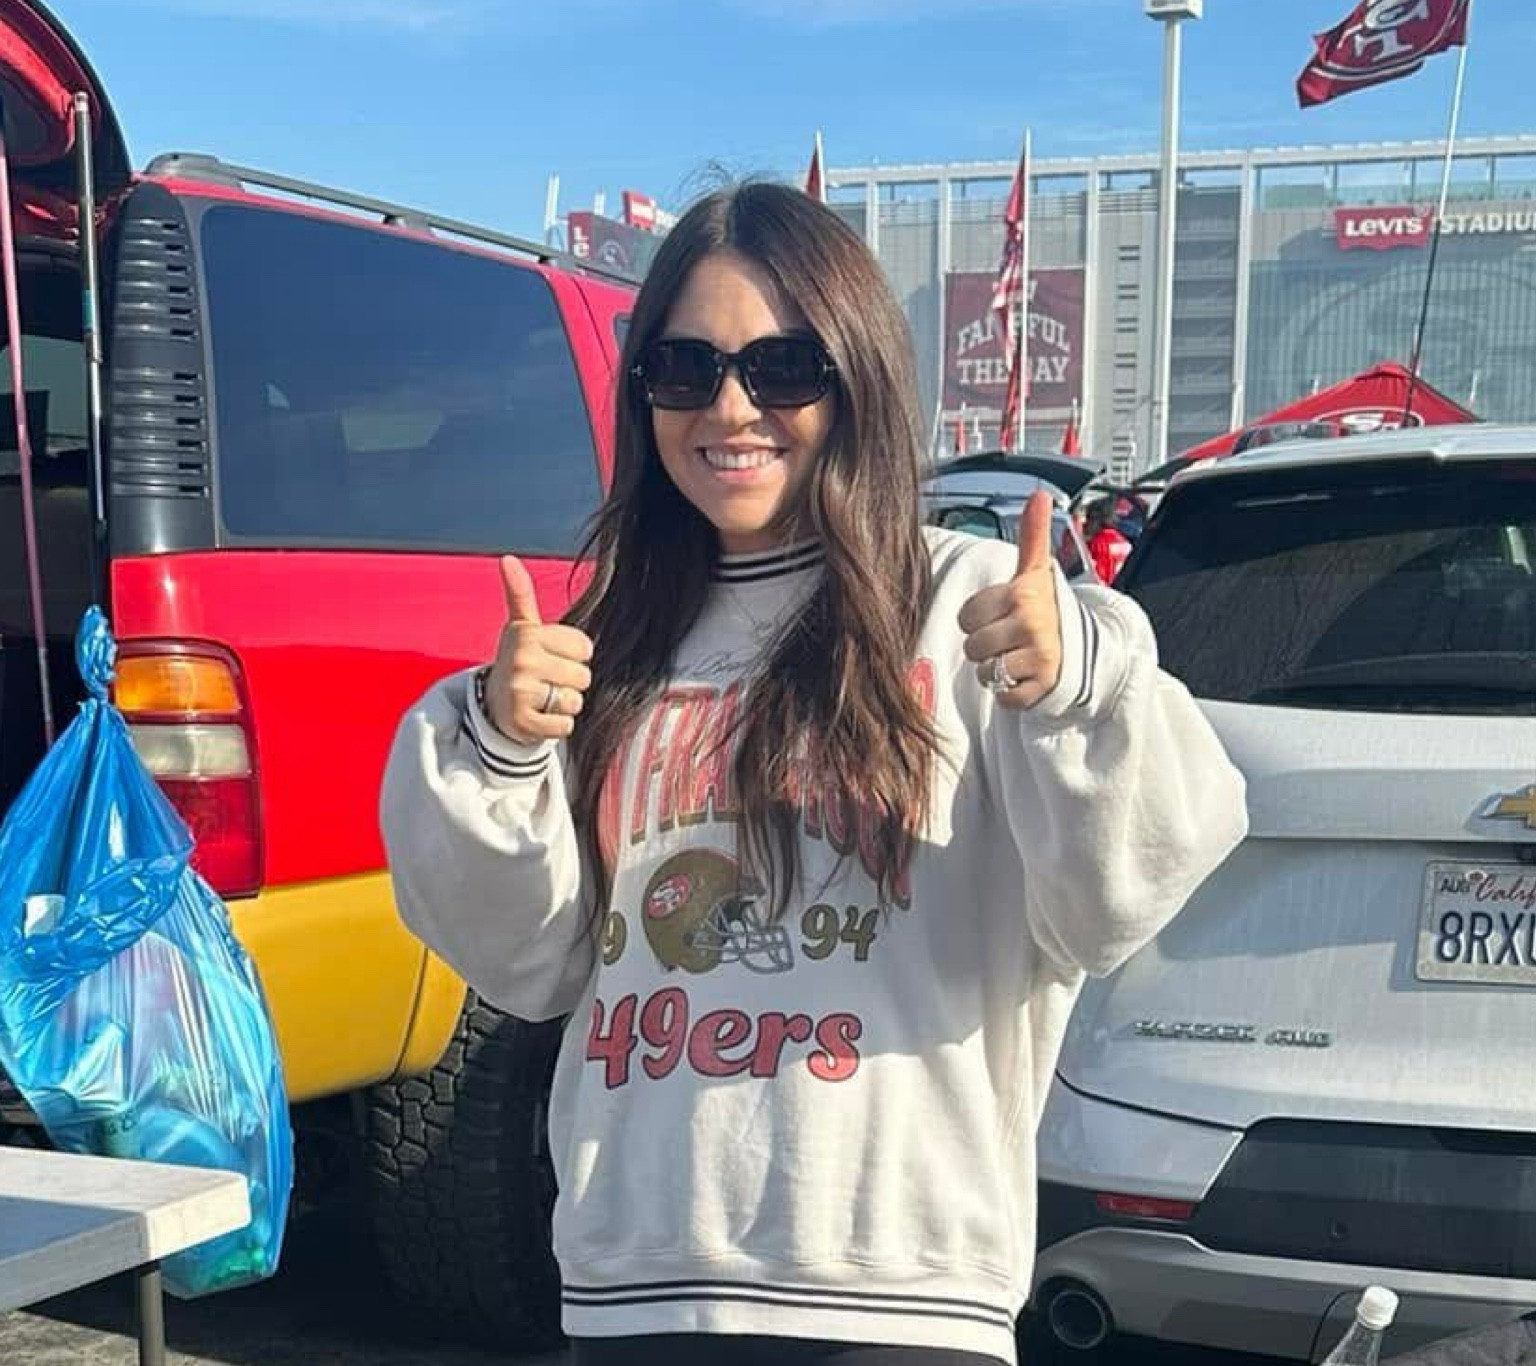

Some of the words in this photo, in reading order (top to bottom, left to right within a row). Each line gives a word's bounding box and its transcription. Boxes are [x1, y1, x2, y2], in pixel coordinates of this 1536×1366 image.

[1441, 212, 1536, 233] STADIU
[957, 312, 1071, 356] FAIFUL
[957, 357, 1009, 385] THE
[603, 910, 627, 966] 9
[801, 903, 880, 961] 94
[586, 987, 863, 1090] 49ers
